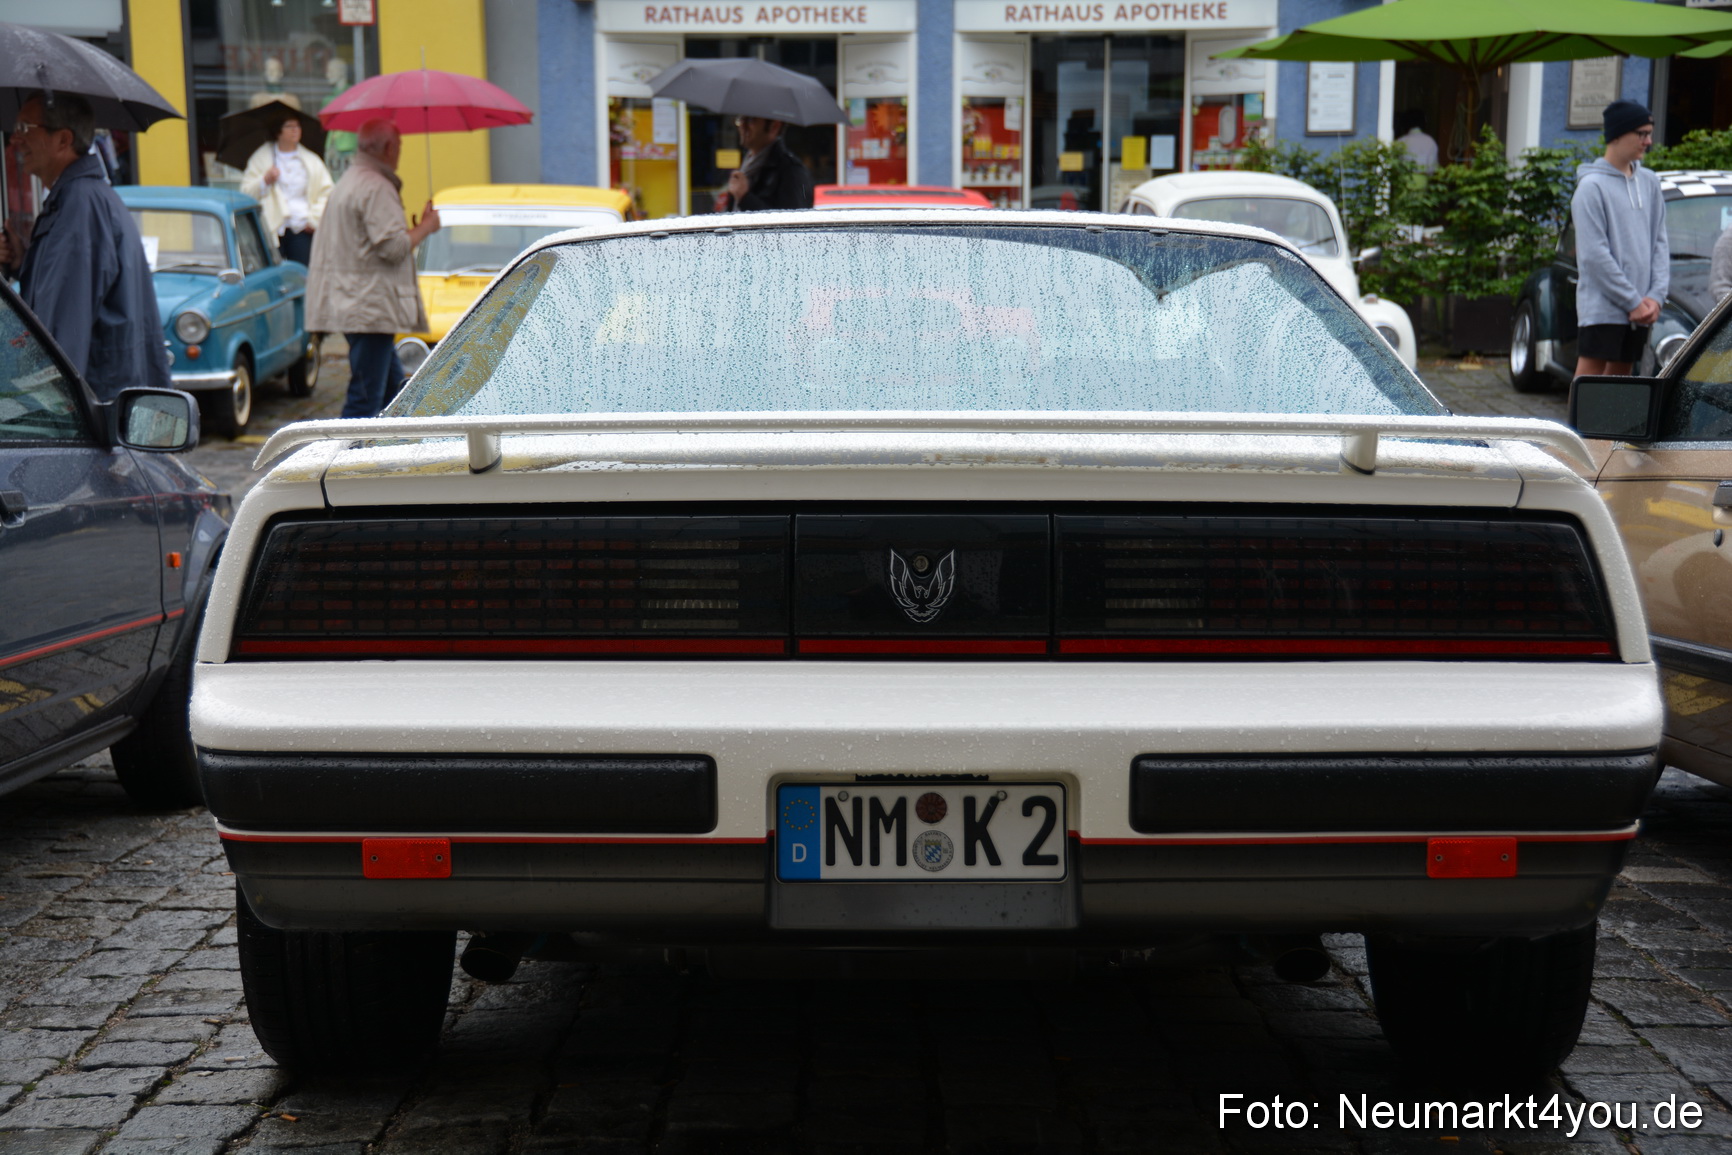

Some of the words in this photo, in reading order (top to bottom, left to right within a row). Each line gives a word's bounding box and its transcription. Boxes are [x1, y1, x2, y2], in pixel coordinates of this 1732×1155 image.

[644, 6, 743, 24] RATHAUS
[756, 6, 868, 24] APOTHEKE
[1004, 4, 1104, 22] RATHAUS
[1114, 2, 1228, 21] APOTHEKE
[825, 796, 907, 867] NM
[963, 796, 1002, 867] K
[1021, 795, 1059, 866] 2
[792, 843, 807, 863] D
